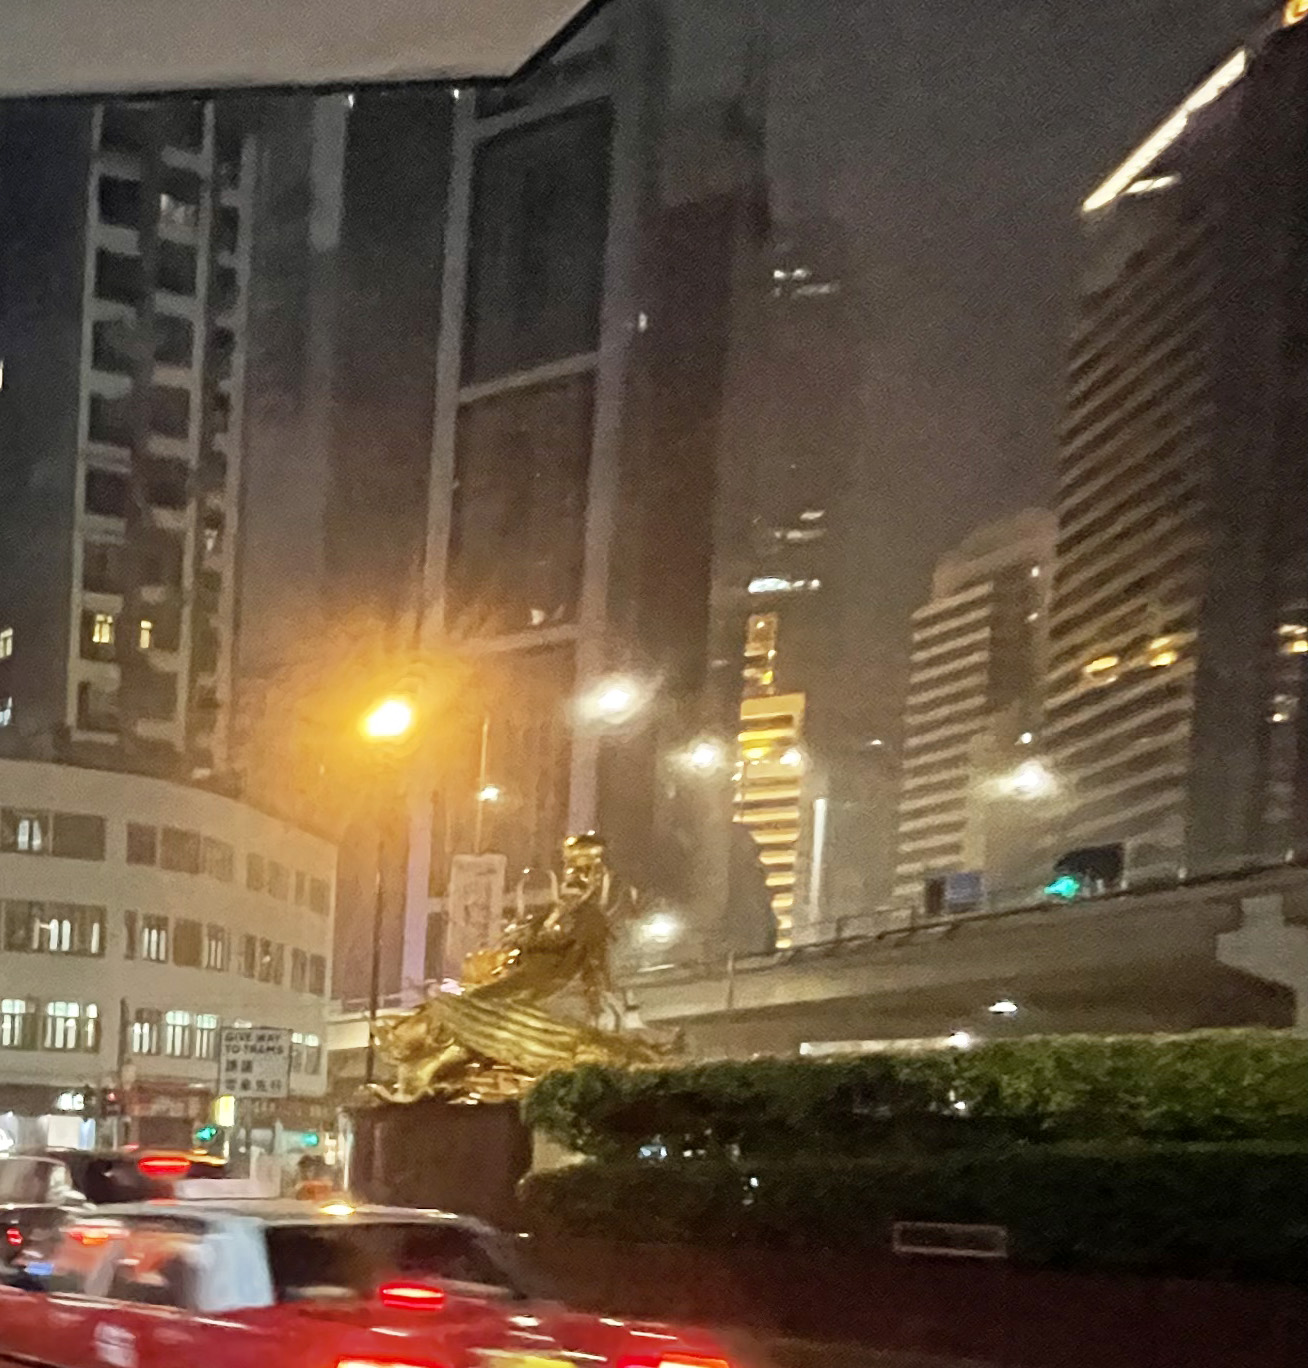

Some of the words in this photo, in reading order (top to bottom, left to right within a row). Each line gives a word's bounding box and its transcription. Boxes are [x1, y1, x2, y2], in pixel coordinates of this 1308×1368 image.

[225, 1032, 252, 1042] GIVE
[256, 1033, 281, 1042] WAY
[225, 1044, 240, 1054] TO
[244, 1044, 284, 1055] TRAMS
